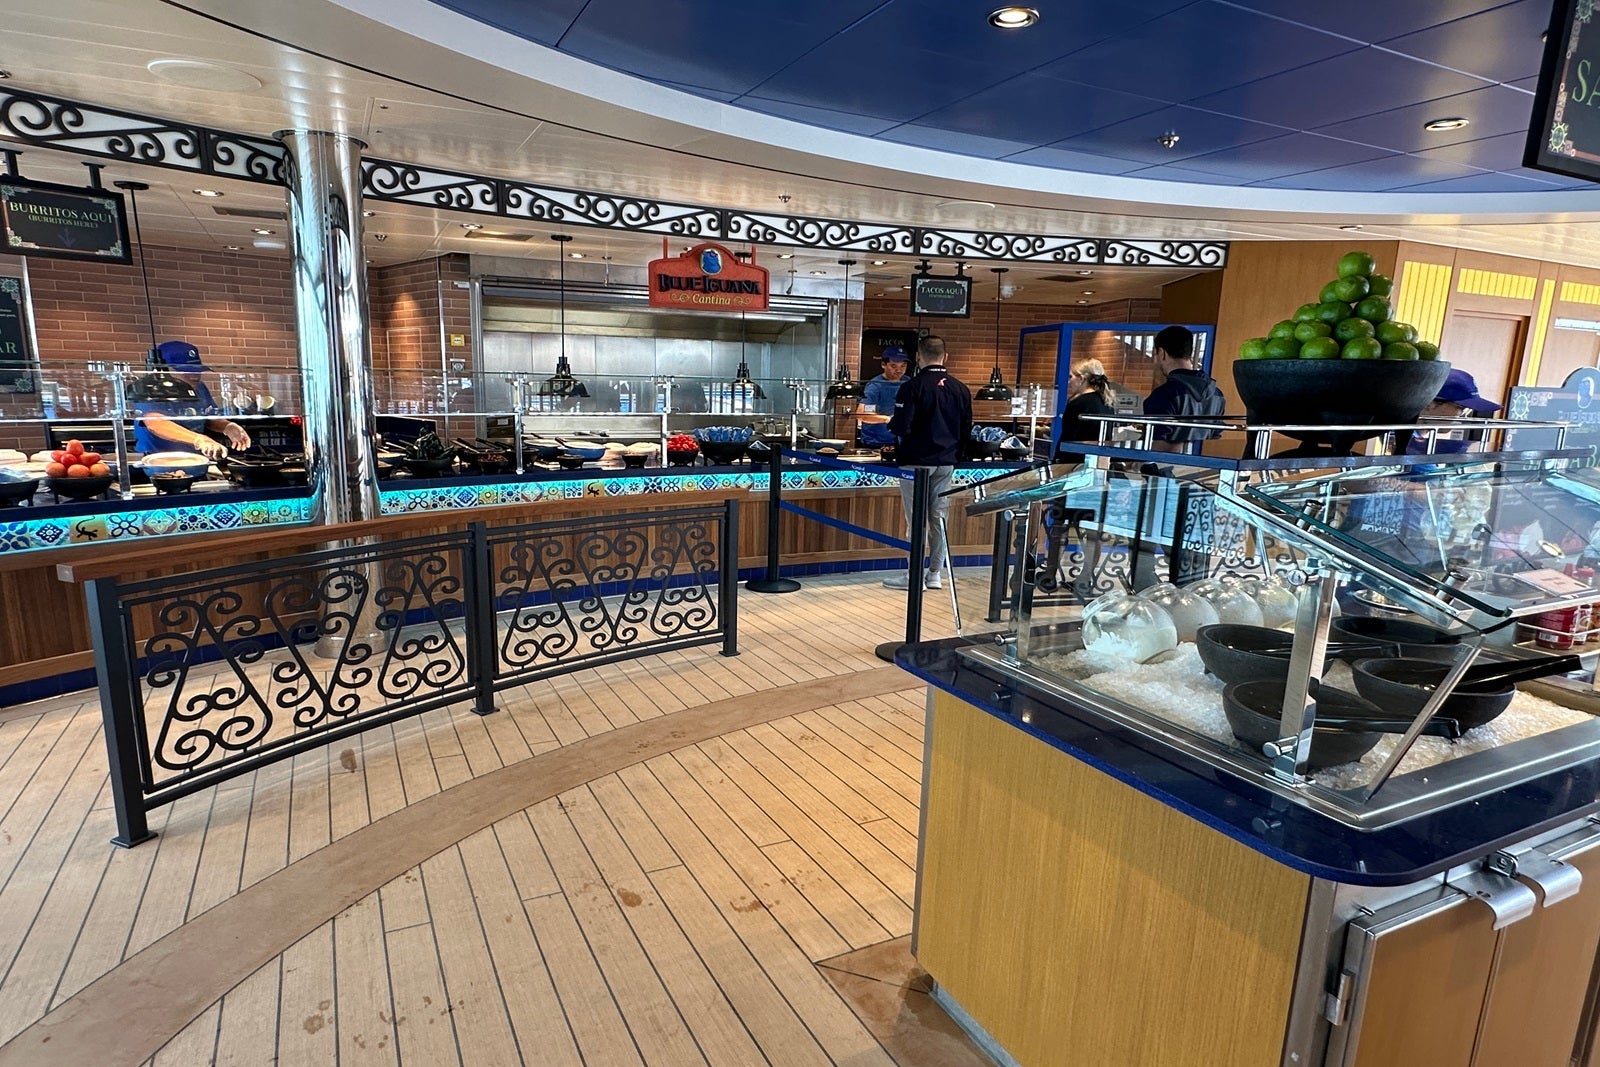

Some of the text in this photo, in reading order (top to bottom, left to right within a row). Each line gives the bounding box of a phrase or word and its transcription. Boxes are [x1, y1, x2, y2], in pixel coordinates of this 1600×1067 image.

[9, 201, 113, 224] BURRITOS AQUI
[657, 273, 761, 295] BLUE IGUANA
[920, 286, 963, 296] TACOS AQUI
[692, 293, 731, 305] Cantina
[878, 338, 905, 346] TACOS
